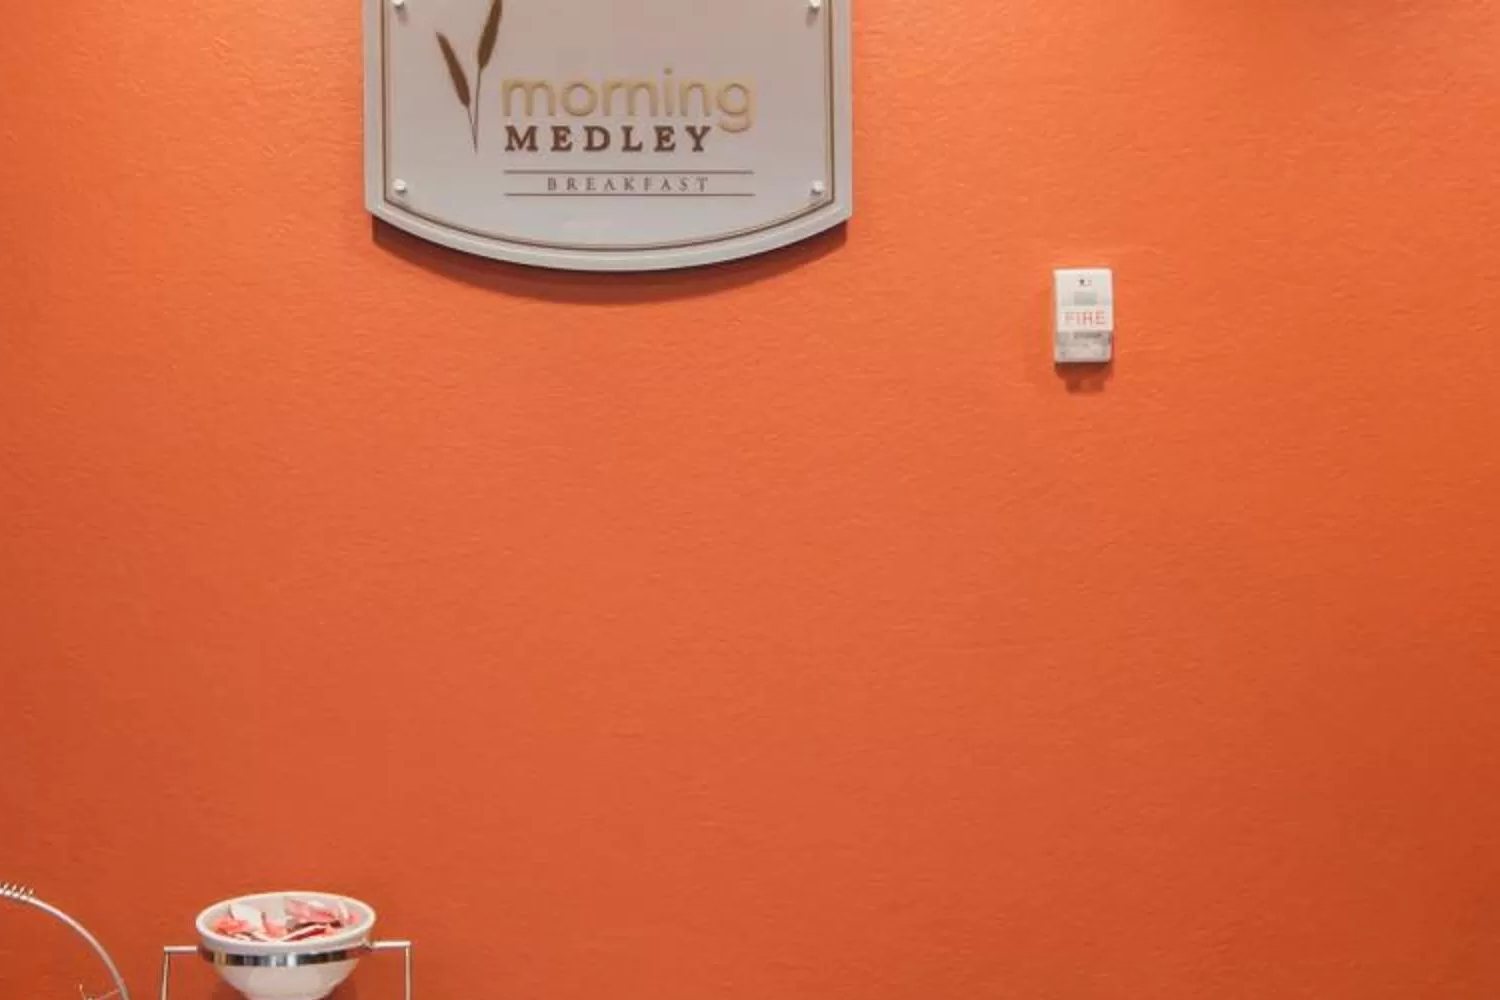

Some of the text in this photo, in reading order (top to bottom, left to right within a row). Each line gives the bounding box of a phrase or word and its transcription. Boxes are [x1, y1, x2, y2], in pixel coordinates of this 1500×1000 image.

[502, 67, 756, 133] morning
[504, 125, 712, 152] MEDLEY
[547, 177, 709, 192] BREAKFAST
[1064, 310, 1106, 325] FIRE
